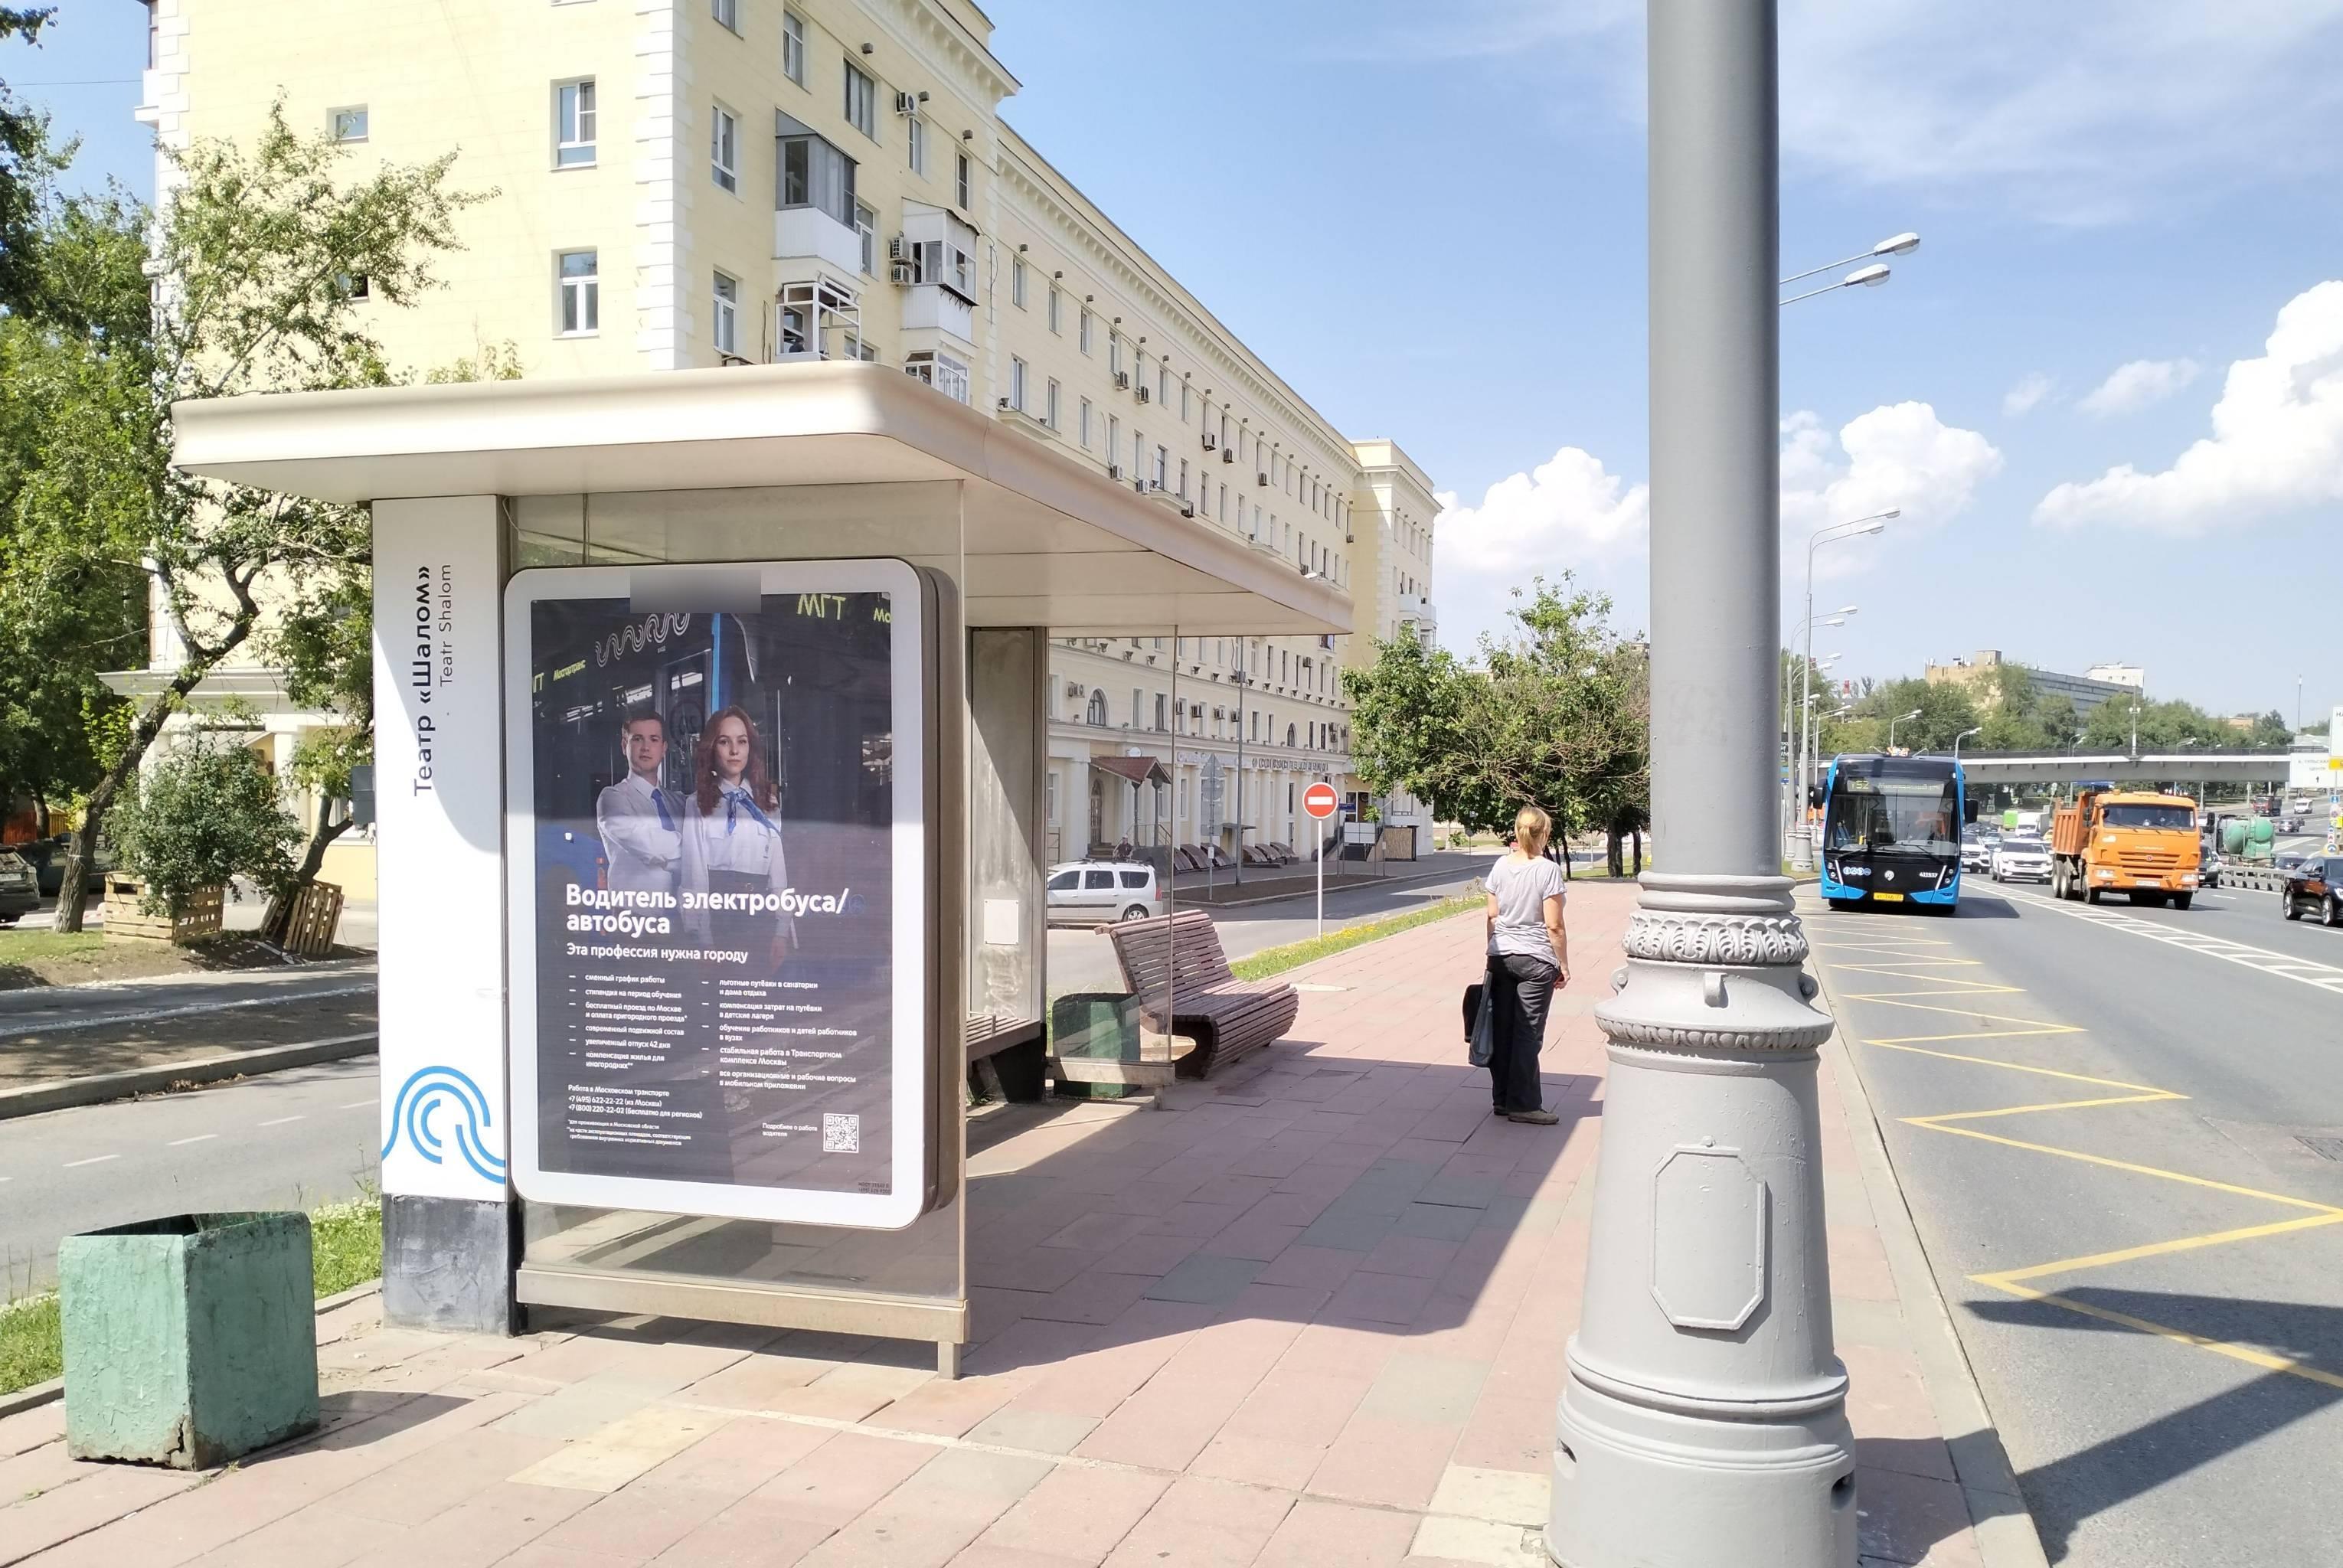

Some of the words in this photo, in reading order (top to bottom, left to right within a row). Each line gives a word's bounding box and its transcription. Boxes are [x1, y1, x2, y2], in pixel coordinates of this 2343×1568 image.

[438, 564, 451, 632] Shalom
[796, 593, 846, 620] МГТ
[412, 566, 431, 704] «Шалом»
[440, 641, 453, 686] Teatr
[532, 672, 544, 693] ГТ
[414, 715, 436, 796] Театр
[567, 884, 676, 910] Водитель
[682, 888, 849, 916] электробуса/
[567, 910, 670, 938] автобуса
[567, 942, 588, 956] Эта
[591, 944, 658, 959] профессия
[661, 949, 701, 962] нужна
[704, 950, 748, 963] городу
